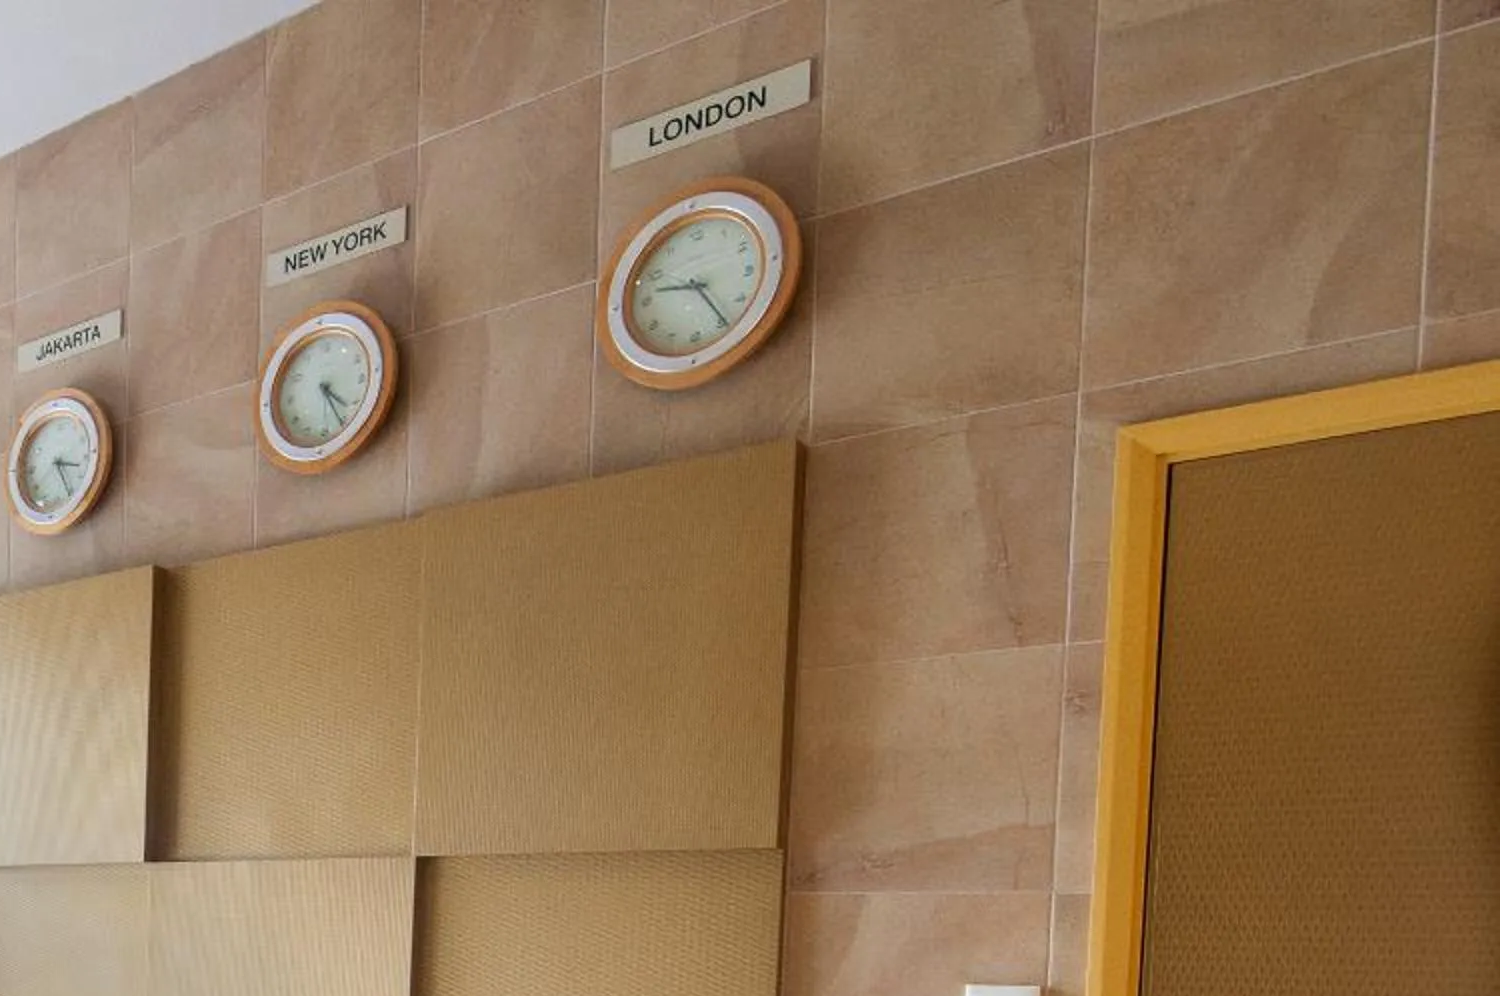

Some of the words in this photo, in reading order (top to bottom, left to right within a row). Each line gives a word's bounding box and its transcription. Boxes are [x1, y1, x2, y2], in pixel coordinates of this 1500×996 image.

[648, 86, 767, 147] LONDON
[283, 242, 328, 273] NEW
[331, 221, 387, 256] YORK
[36, 325, 101, 361] JAKARTA
